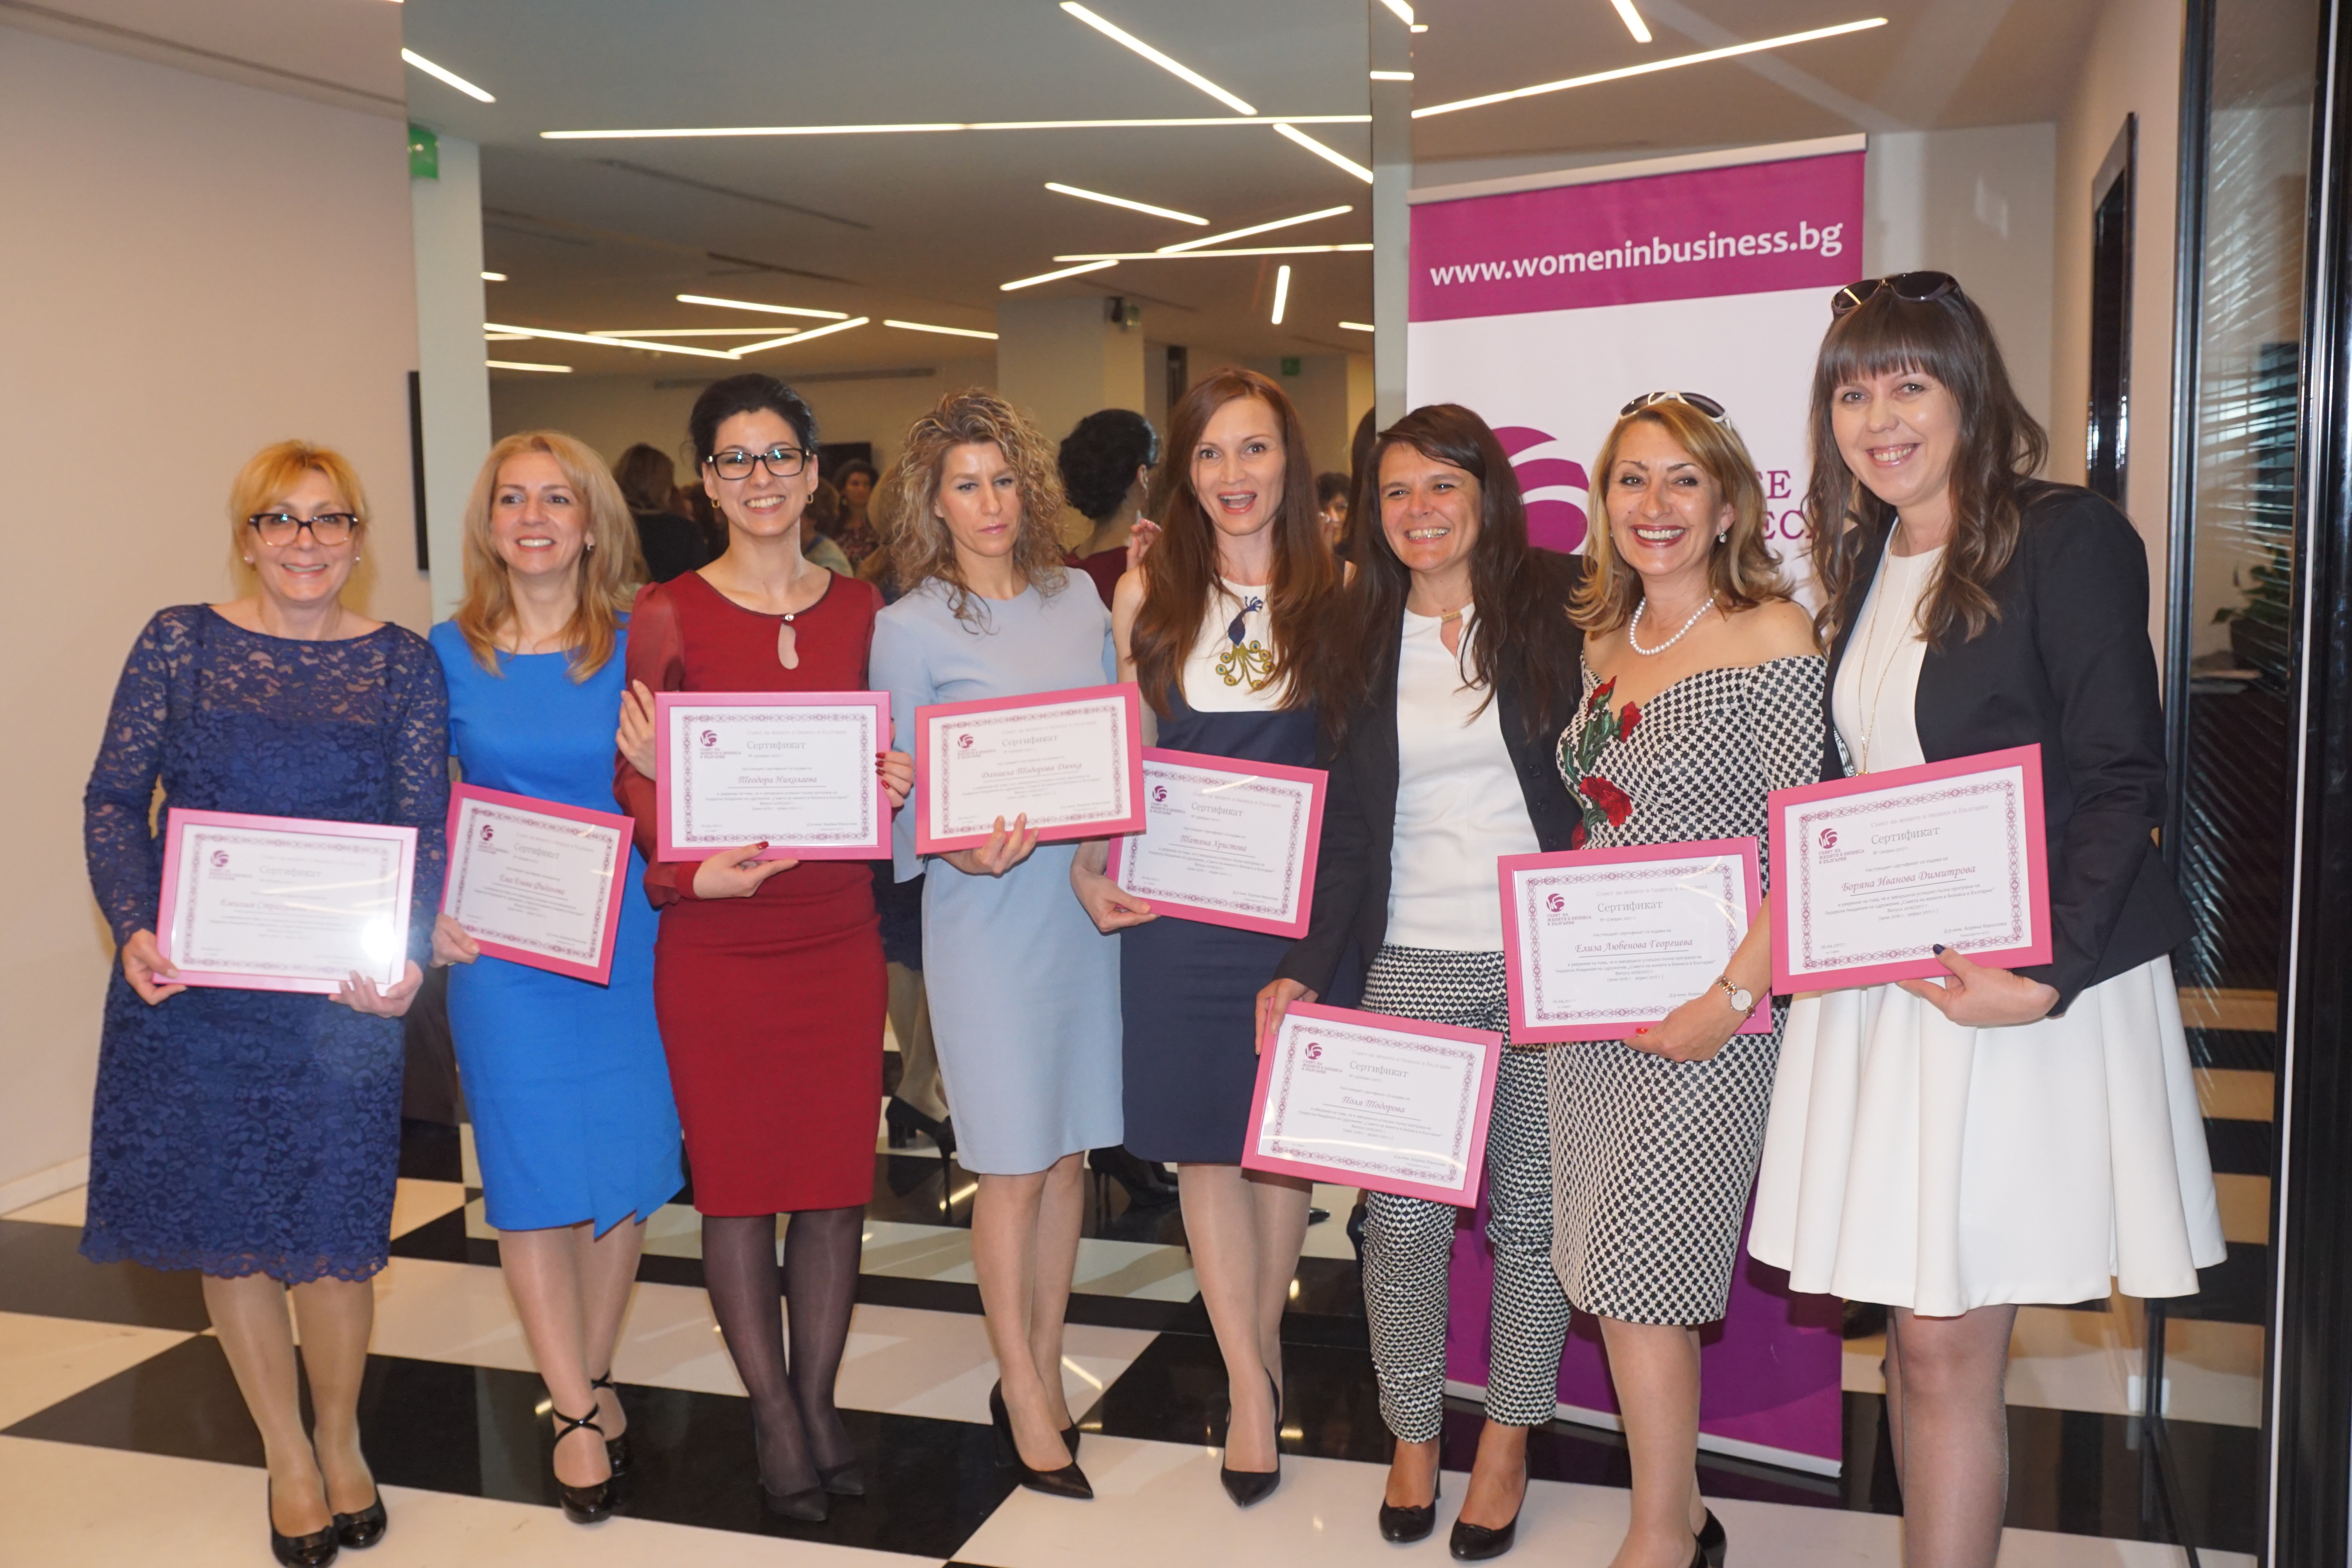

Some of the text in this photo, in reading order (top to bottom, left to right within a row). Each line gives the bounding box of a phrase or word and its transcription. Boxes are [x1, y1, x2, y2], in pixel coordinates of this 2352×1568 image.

[1430, 221, 1843, 286] www.womeninbusiness.bg
[747, 741, 806, 750] Сертификат
[1002, 734, 1058, 747] Сертификат
[1191, 802, 1243, 818] Сертификат
[1871, 825, 1940, 846] Сертификат
[1842, 864, 1976, 894] Боряна Иванова Димитрова
[1597, 899, 1663, 913] Сертификат
[1575, 938, 1693, 952] Елиза Любенова Георгиева
[1349, 1060, 1409, 1079] Сертификат
[1341, 1095, 1405, 1115] Поля Тодорова
